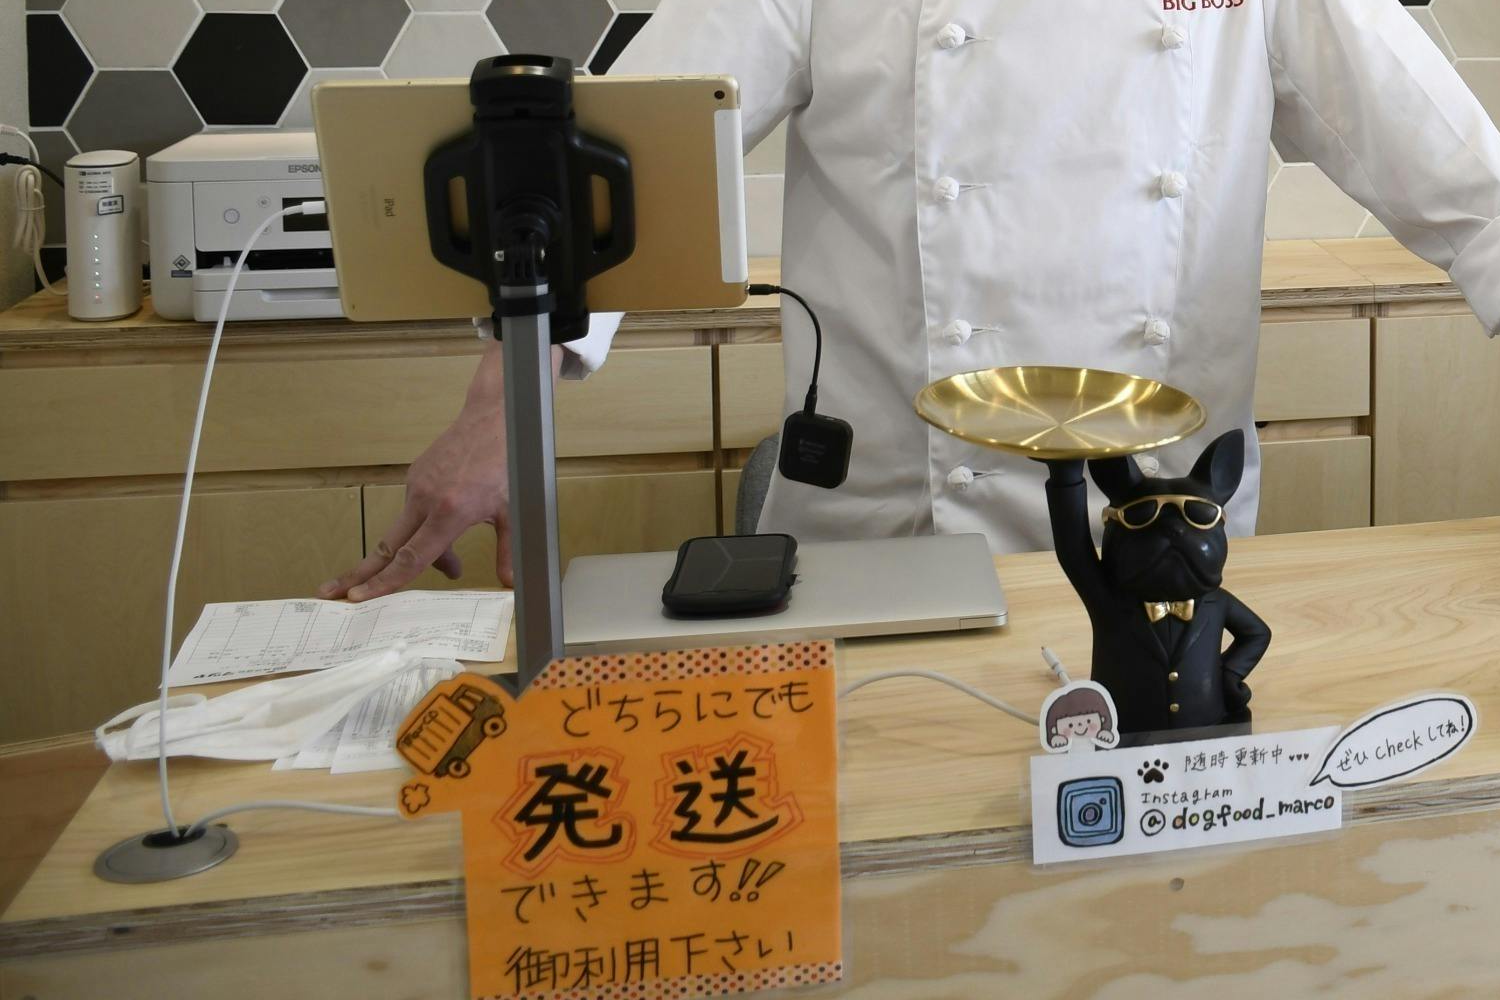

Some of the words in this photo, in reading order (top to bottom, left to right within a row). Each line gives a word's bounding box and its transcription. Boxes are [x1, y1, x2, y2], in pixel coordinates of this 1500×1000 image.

[384, 198, 396, 217] iPad
[560, 681, 815, 737] どちらにでも
[514, 750, 780, 862] 発送
[1140, 795, 1335, 837] @dogfood_marco
[1141, 788, 1233, 805] Instagram
[505, 930, 793, 992] 御利用下さい
